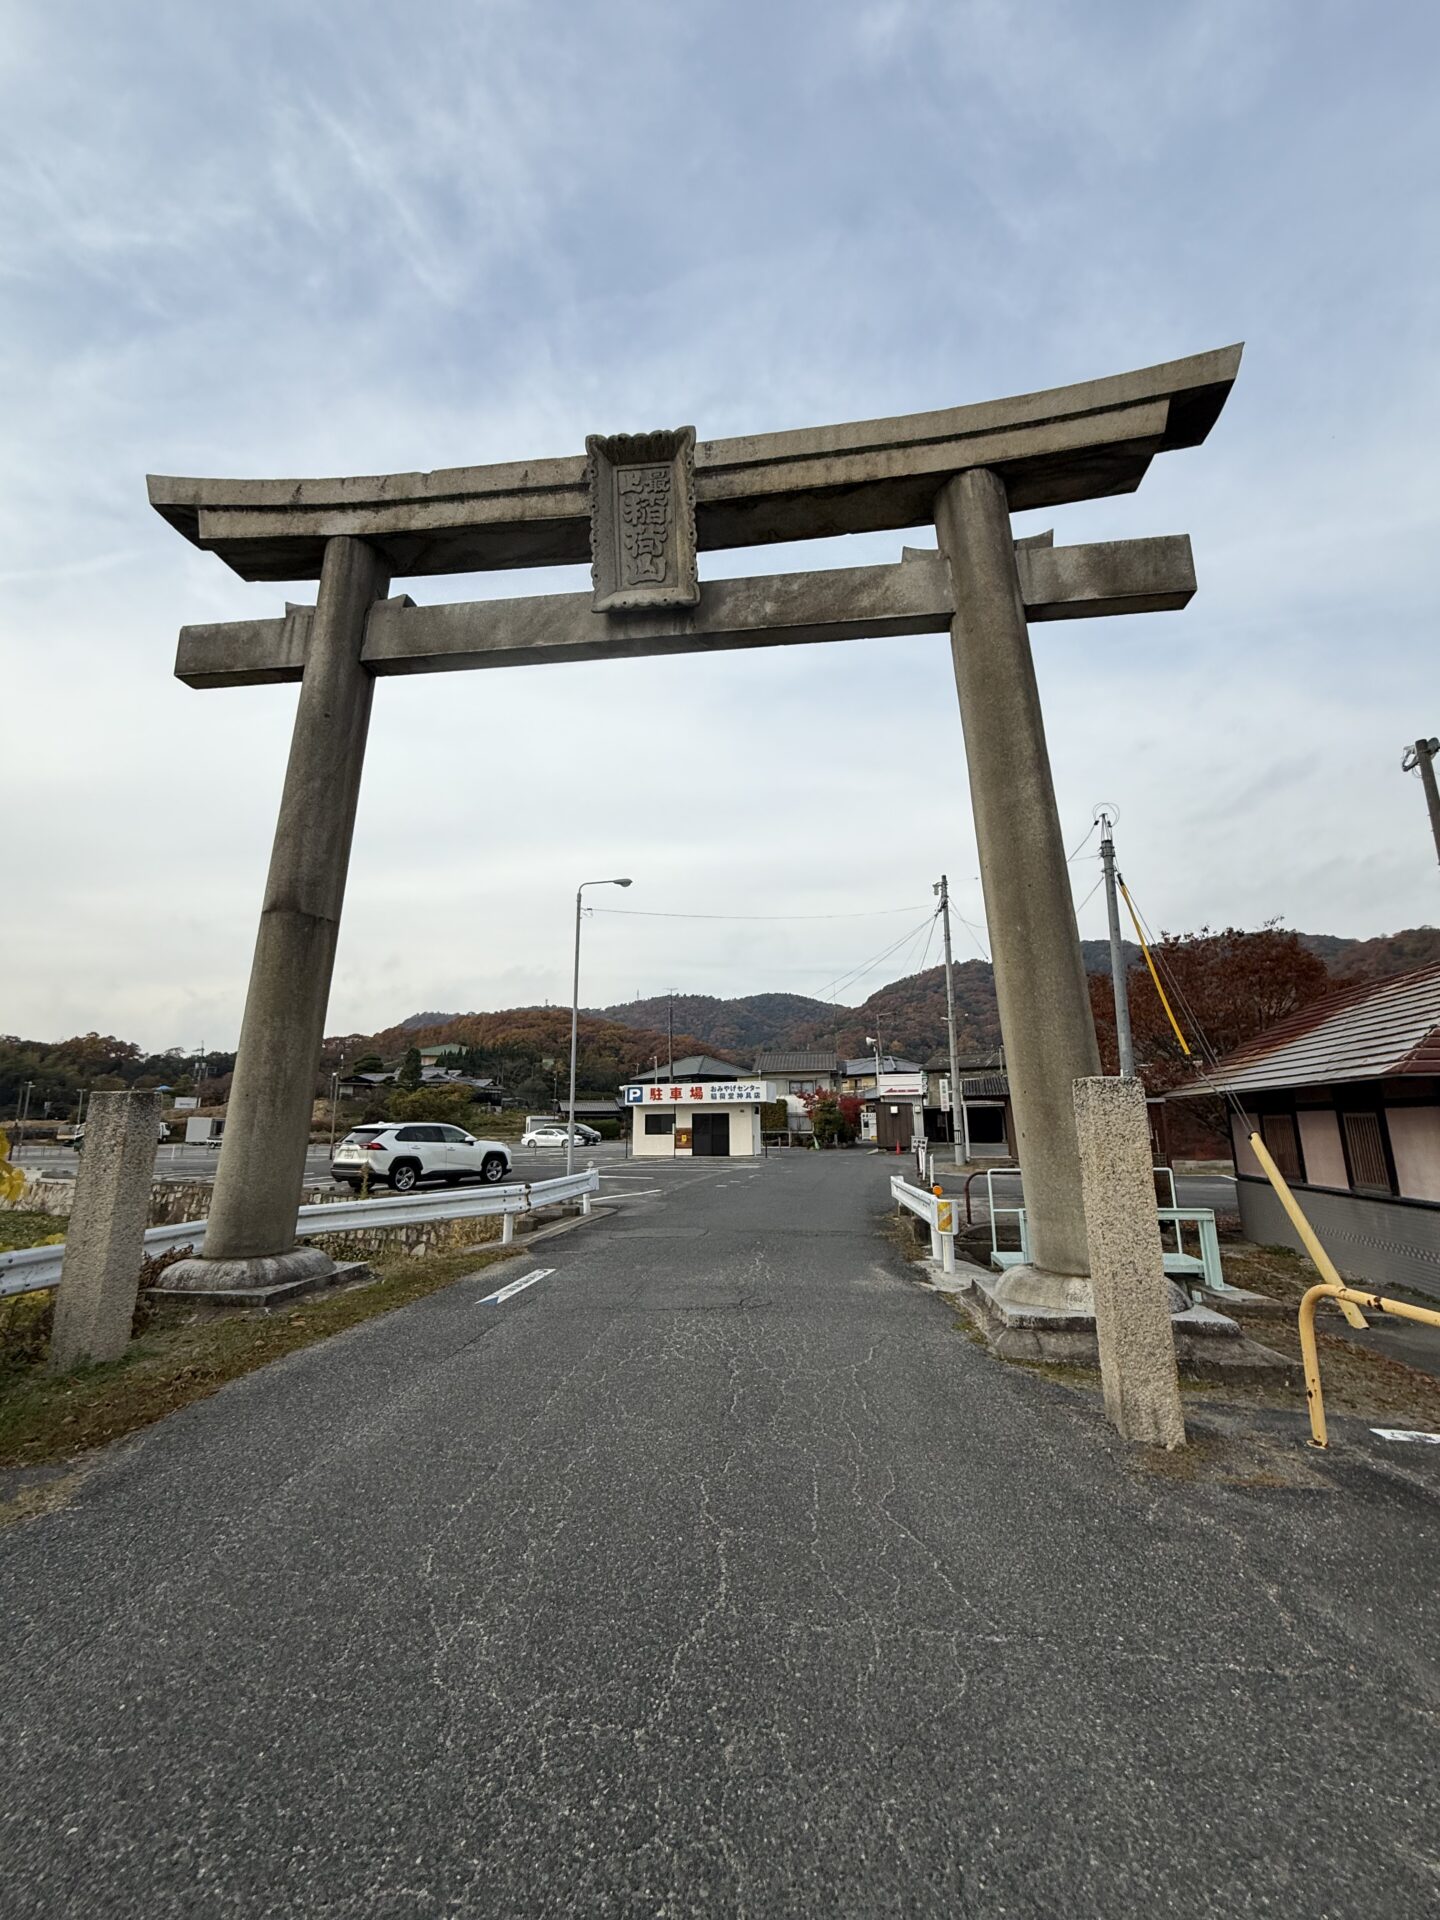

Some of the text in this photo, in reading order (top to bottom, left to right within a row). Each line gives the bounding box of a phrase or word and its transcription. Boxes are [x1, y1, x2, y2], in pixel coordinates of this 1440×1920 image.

[628, 1088, 641, 1101] P
[650, 1086, 703, 1101] 駐車場
[711, 1085, 760, 1093] おみやげセンター
